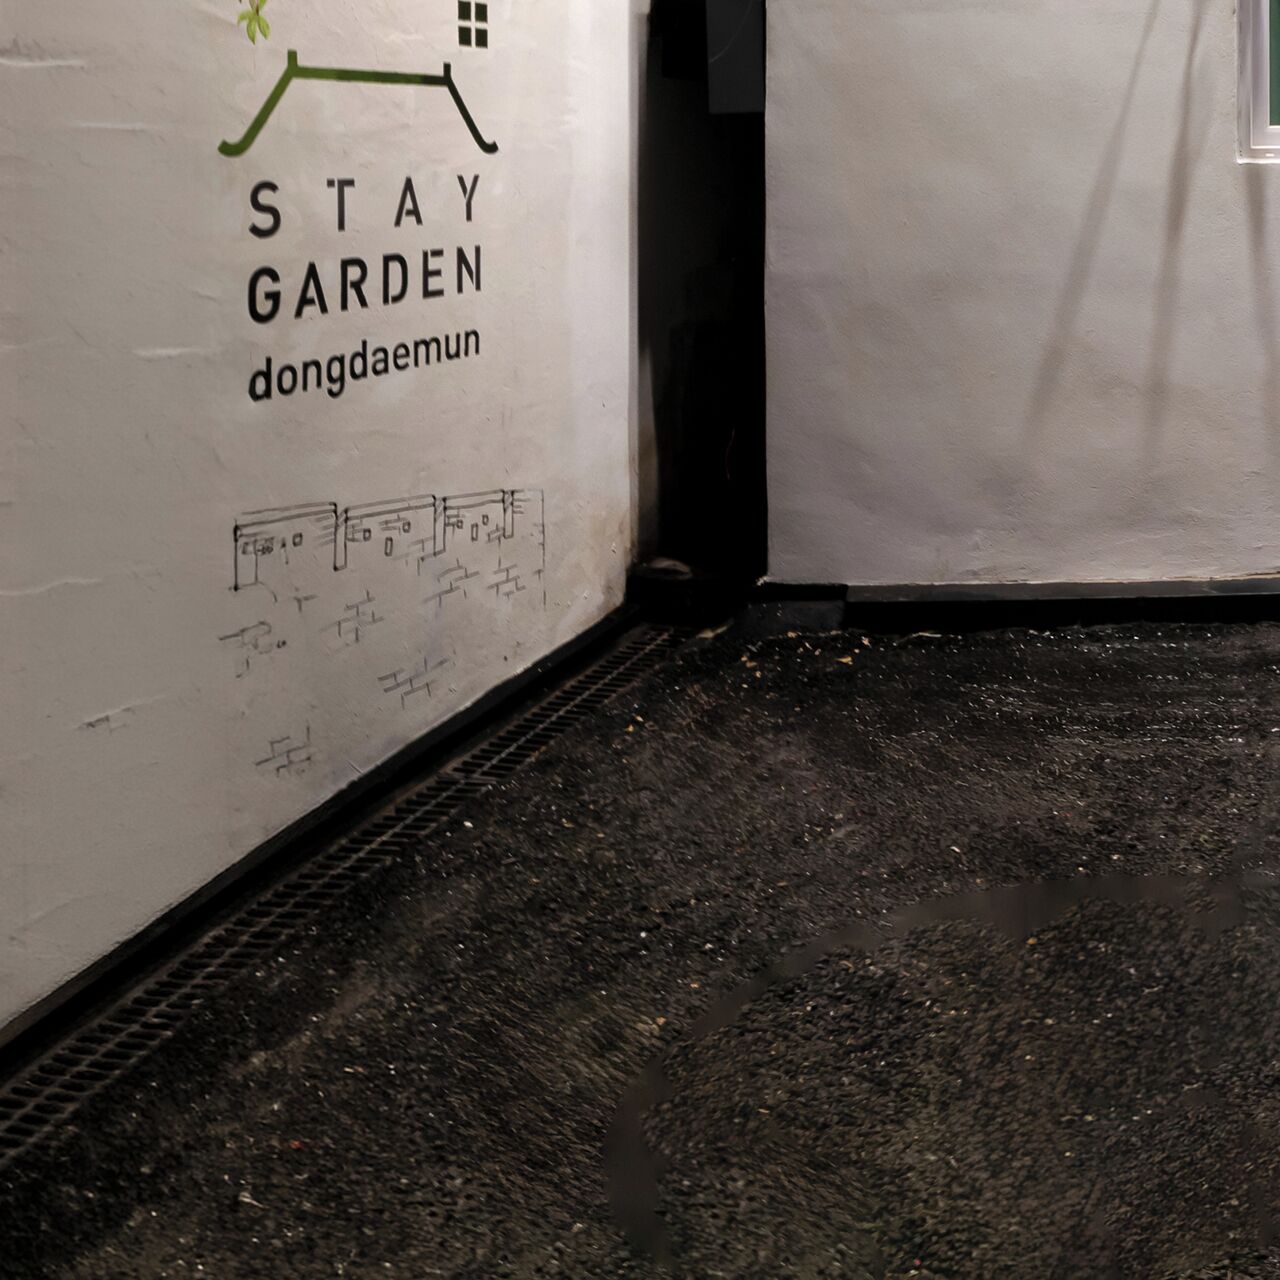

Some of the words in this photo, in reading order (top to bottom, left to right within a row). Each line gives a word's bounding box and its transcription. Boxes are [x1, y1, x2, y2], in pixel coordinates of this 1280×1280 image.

[249, 174, 480, 238] STAY
[248, 245, 482, 324] GARDEN
[248, 328, 480, 402] dongdaemun
